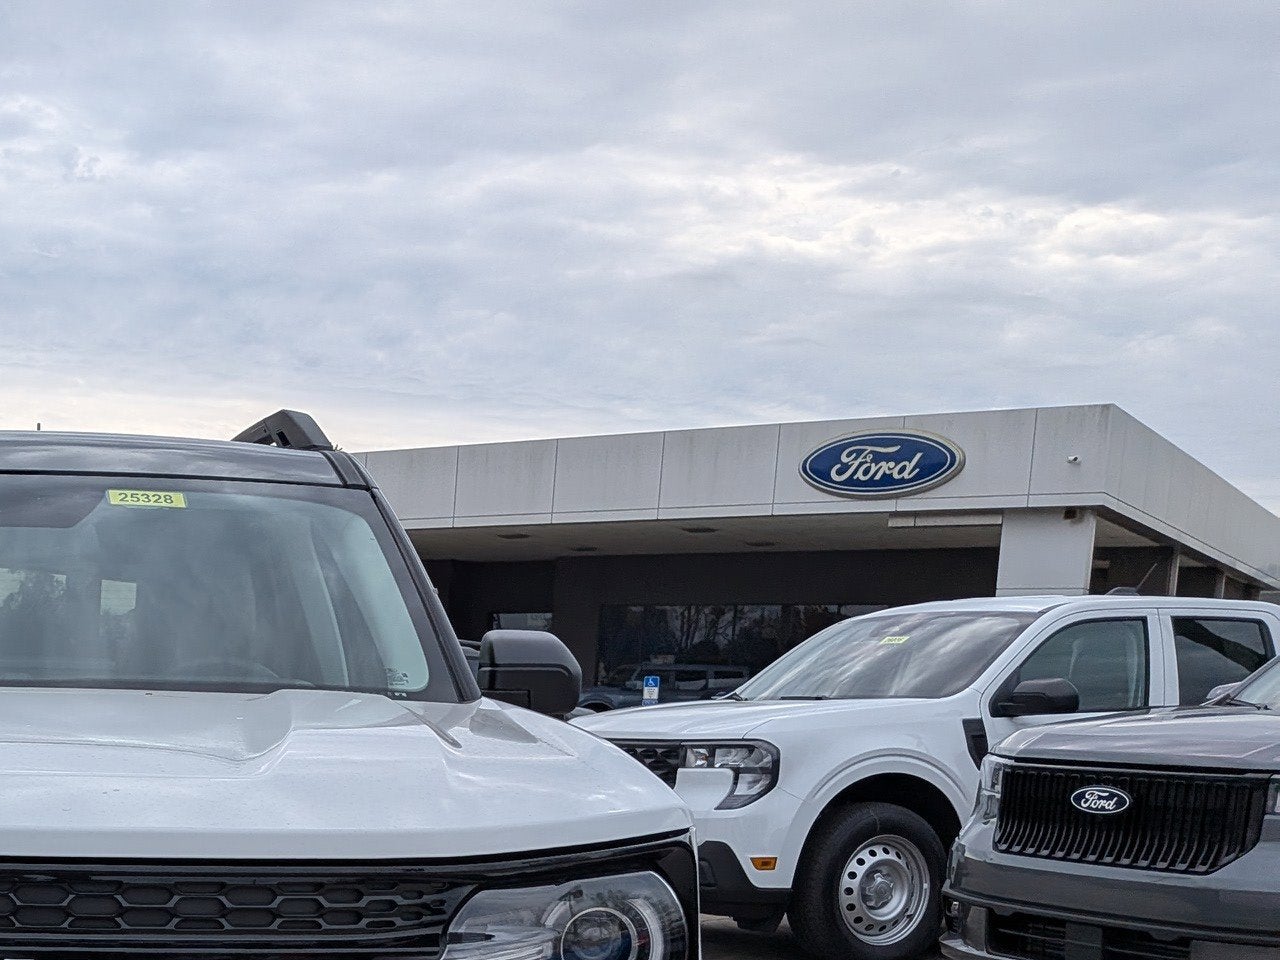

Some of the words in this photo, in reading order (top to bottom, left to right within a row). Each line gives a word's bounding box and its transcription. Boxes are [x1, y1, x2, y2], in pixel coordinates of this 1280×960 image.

[830, 445, 923, 482] Ford
[118, 492, 174, 504] 25328
[1080, 790, 1118, 810] Ford
